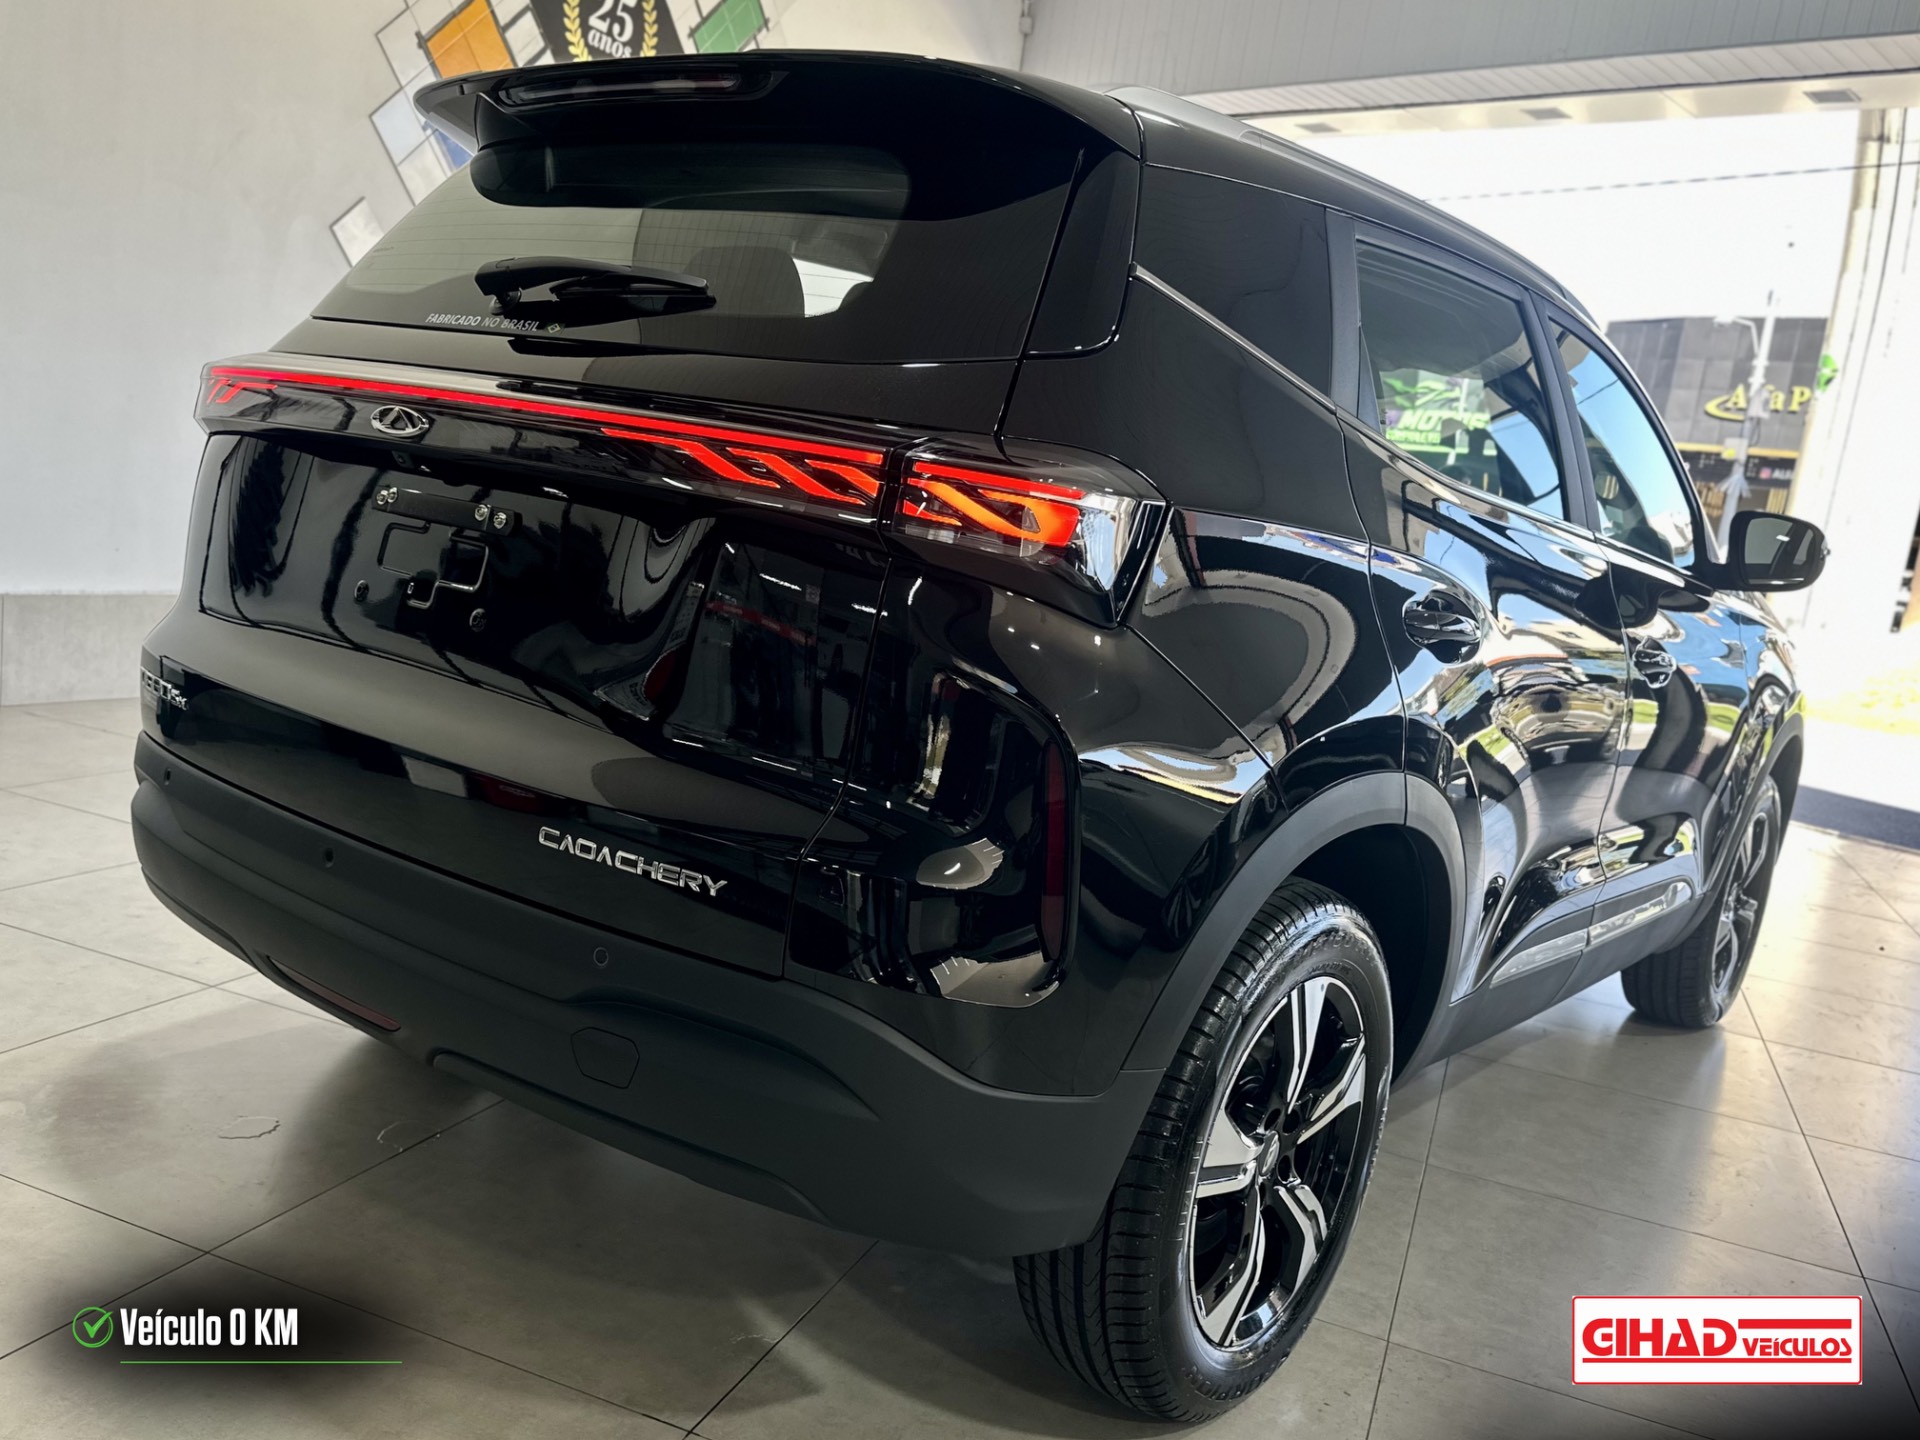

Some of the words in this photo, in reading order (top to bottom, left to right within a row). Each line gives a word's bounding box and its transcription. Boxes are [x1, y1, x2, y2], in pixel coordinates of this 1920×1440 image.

[588, 0, 638, 42] 25
[587, 28, 632, 58] anos
[425, 313, 481, 326] FABRICADO
[480, 316, 500, 328] NO
[500, 318, 540, 332] BRASIL
